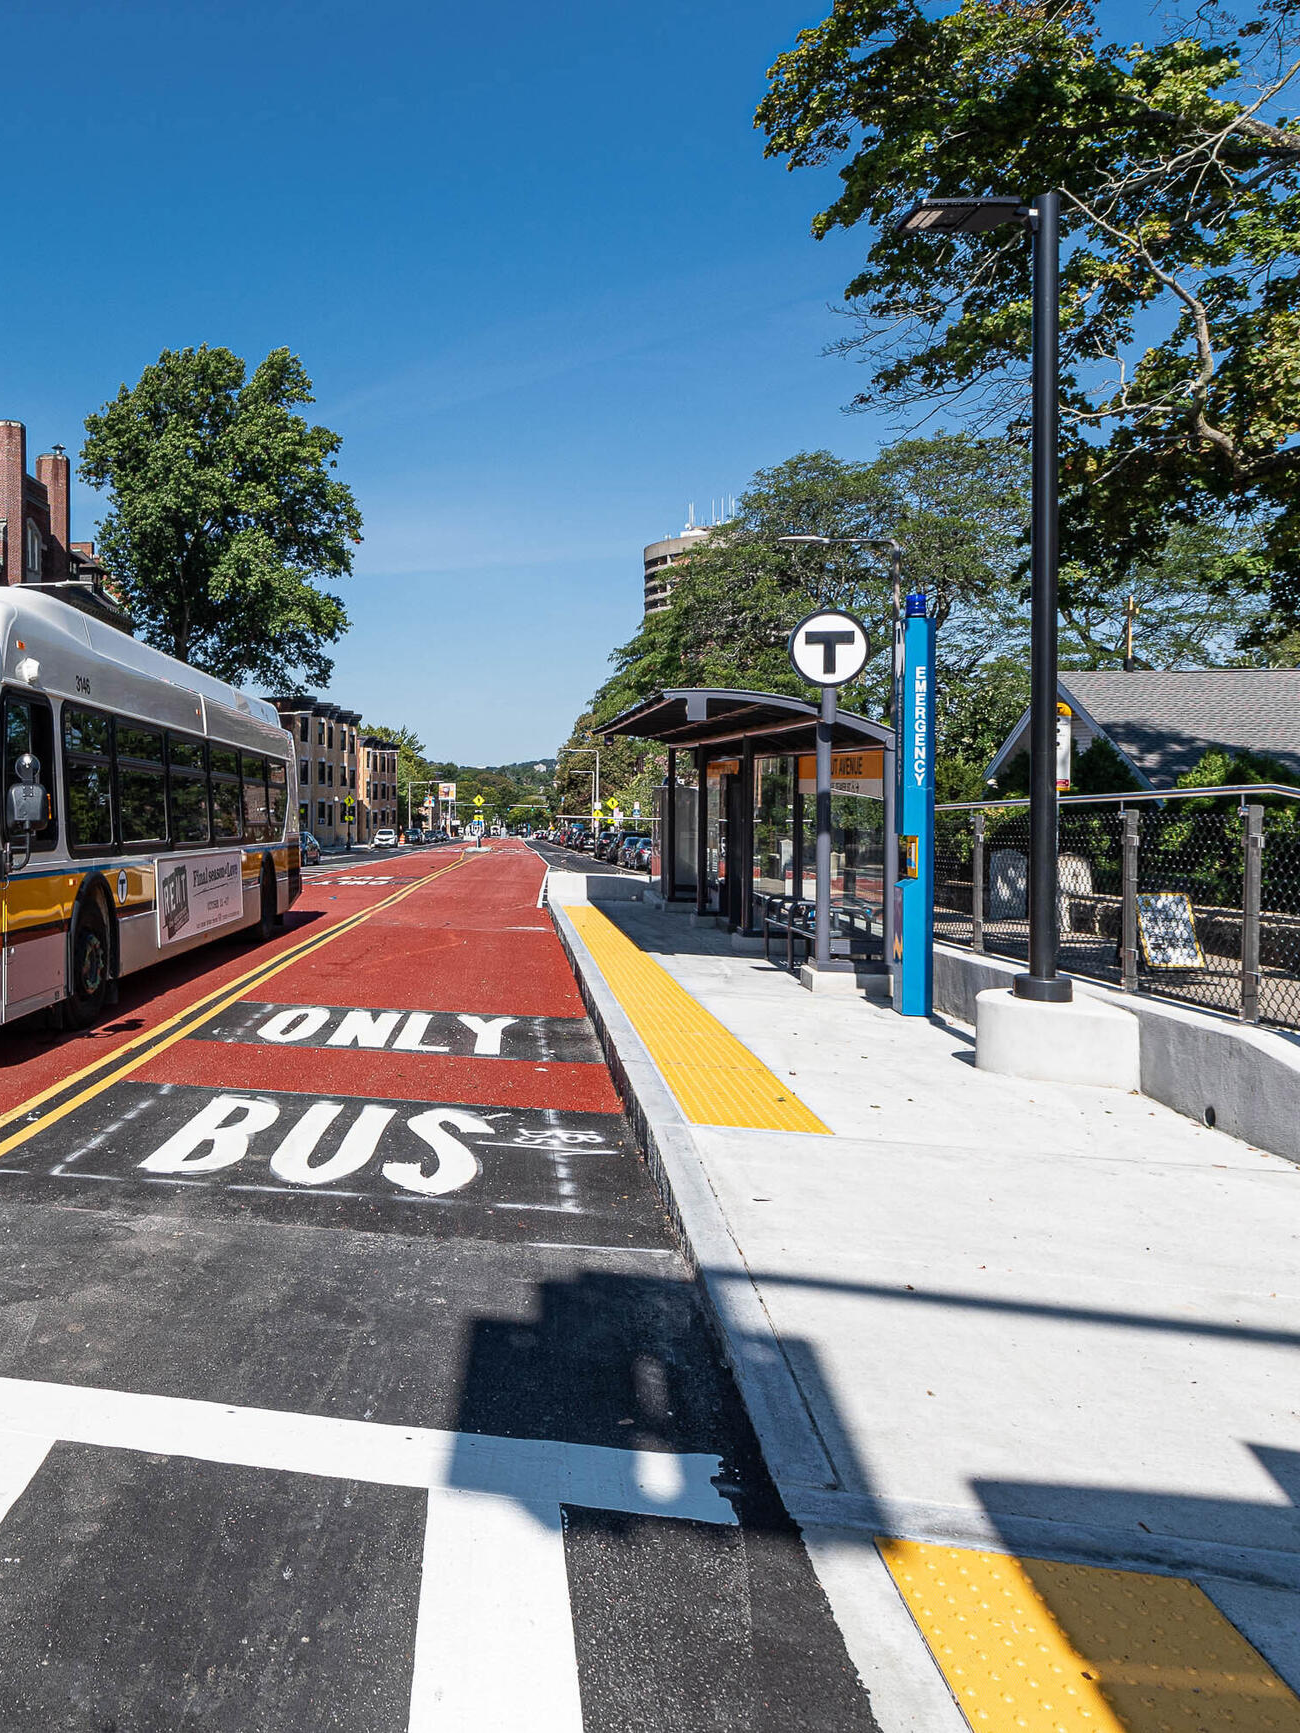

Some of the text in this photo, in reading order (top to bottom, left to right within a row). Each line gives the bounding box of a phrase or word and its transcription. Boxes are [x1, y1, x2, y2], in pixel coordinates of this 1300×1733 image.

[805, 630, 854, 674] T
[75, 675, 91, 695] 3146
[913, 666, 927, 787] EMERGENCY
[119, 879, 126, 900] T
[256, 1006, 519, 1056] ONLY
[137, 1093, 496, 1196] BUS
